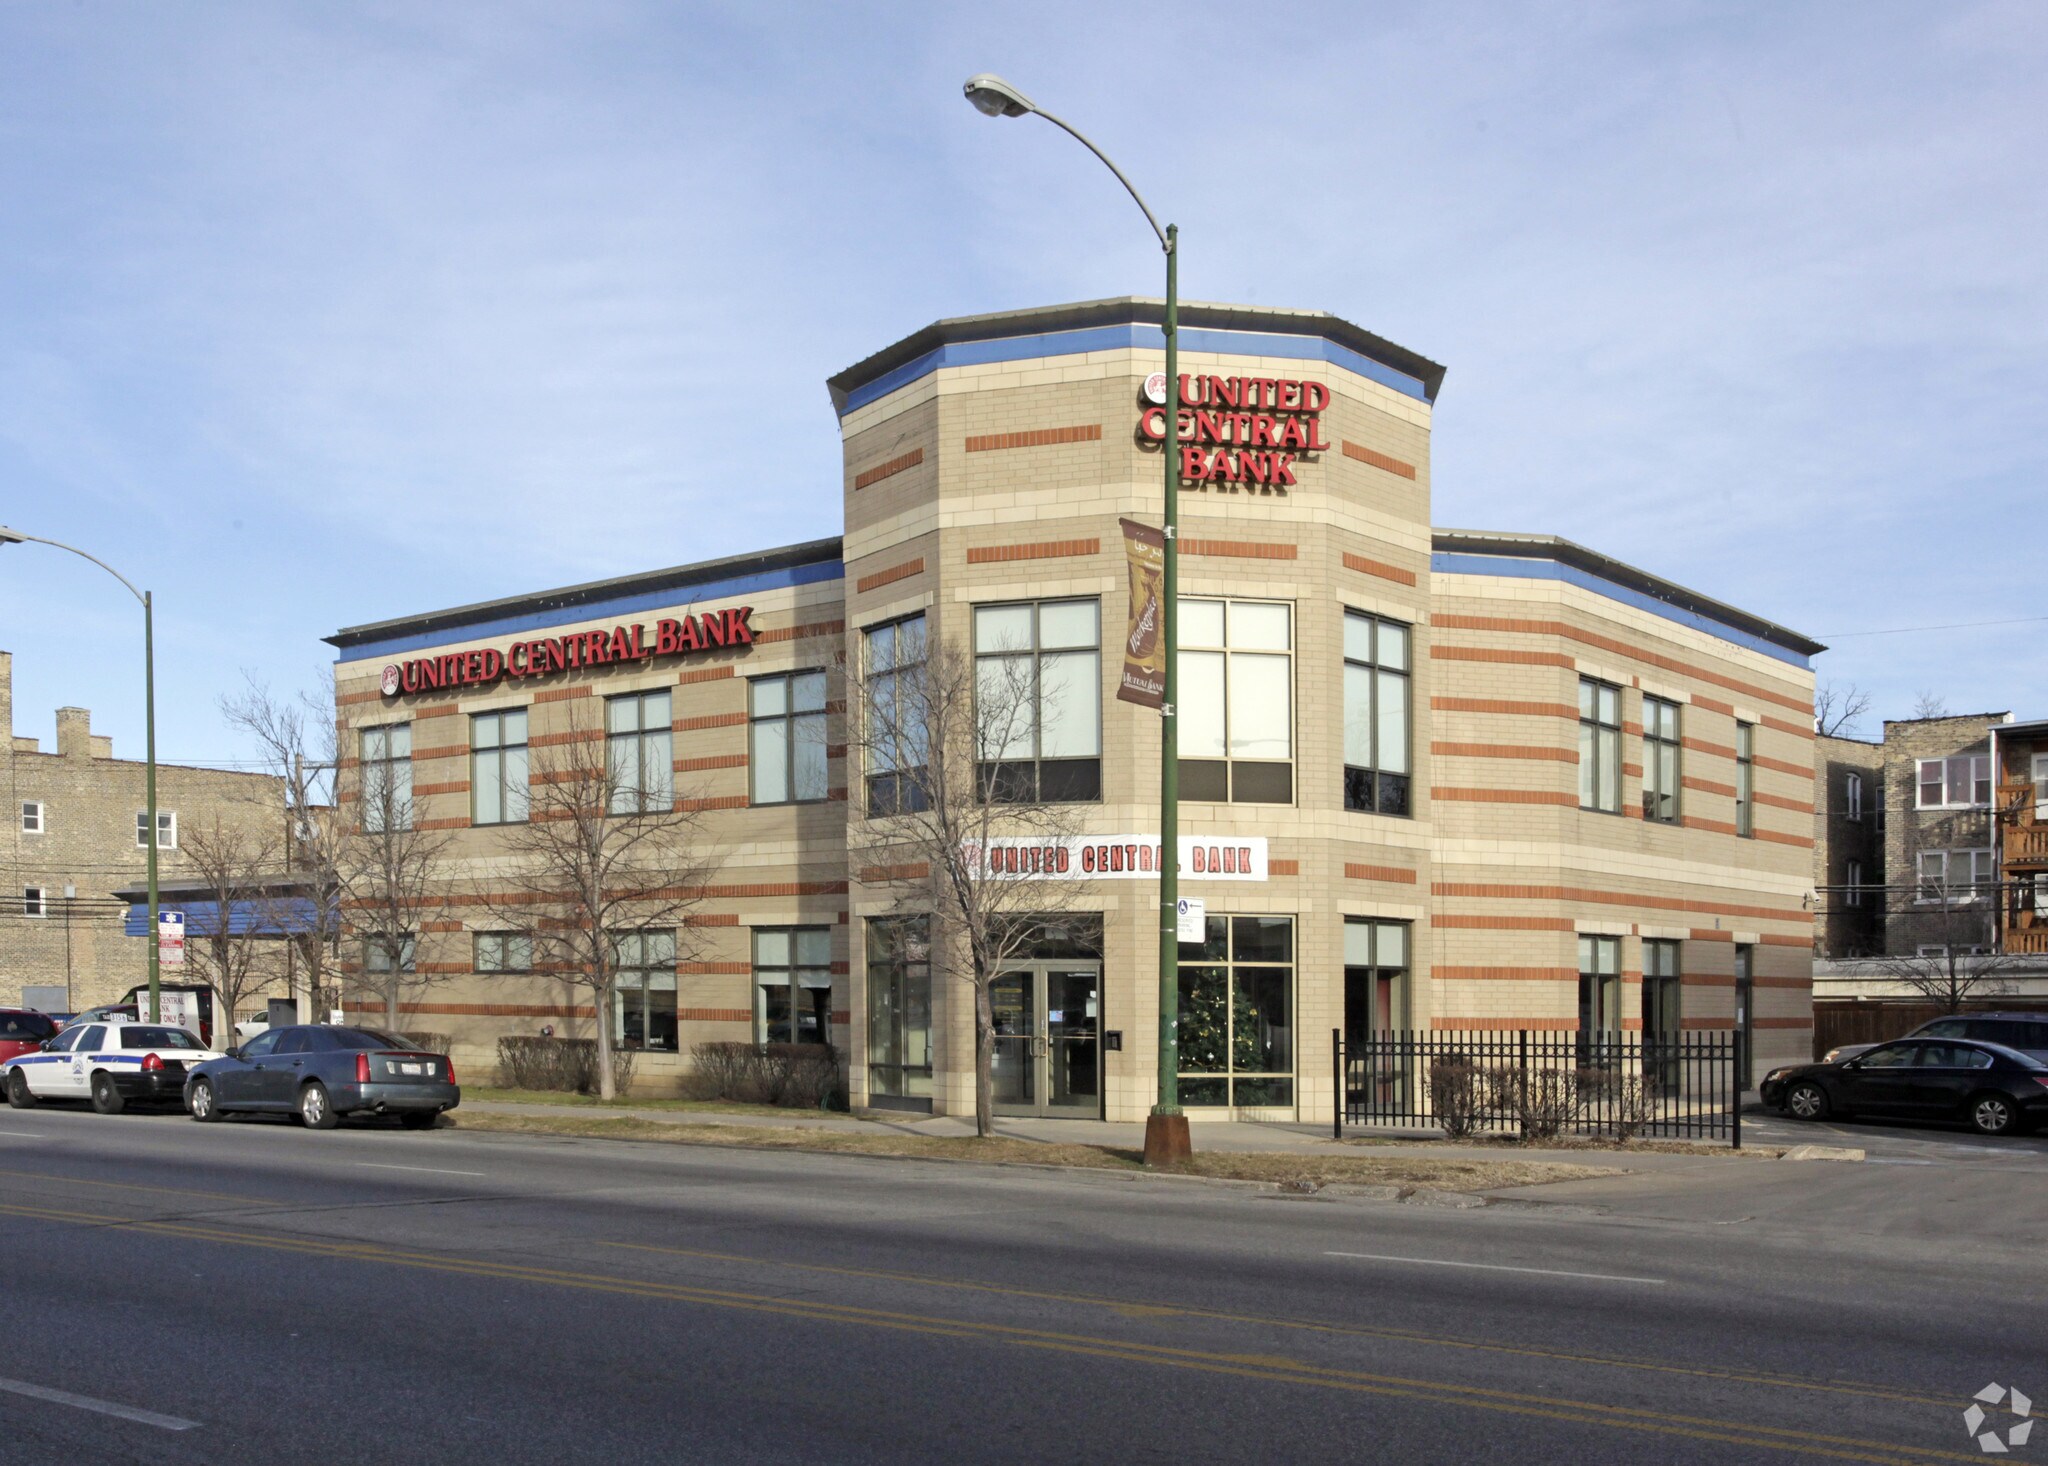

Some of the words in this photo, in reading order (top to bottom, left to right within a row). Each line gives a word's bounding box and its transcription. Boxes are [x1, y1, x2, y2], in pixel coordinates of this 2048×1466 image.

[1178, 373, 1331, 412] UNITED
[1142, 407, 1331, 450] CENTRAL
[1181, 447, 1298, 485] BANK
[402, 647, 501, 693] UNITED
[507, 624, 650, 677] CENTRAL
[656, 607, 754, 655] BANK
[991, 846, 1069, 873] UNITED
[1082, 844, 1181, 873] CENTR
[1193, 846, 1252, 873] BANK
